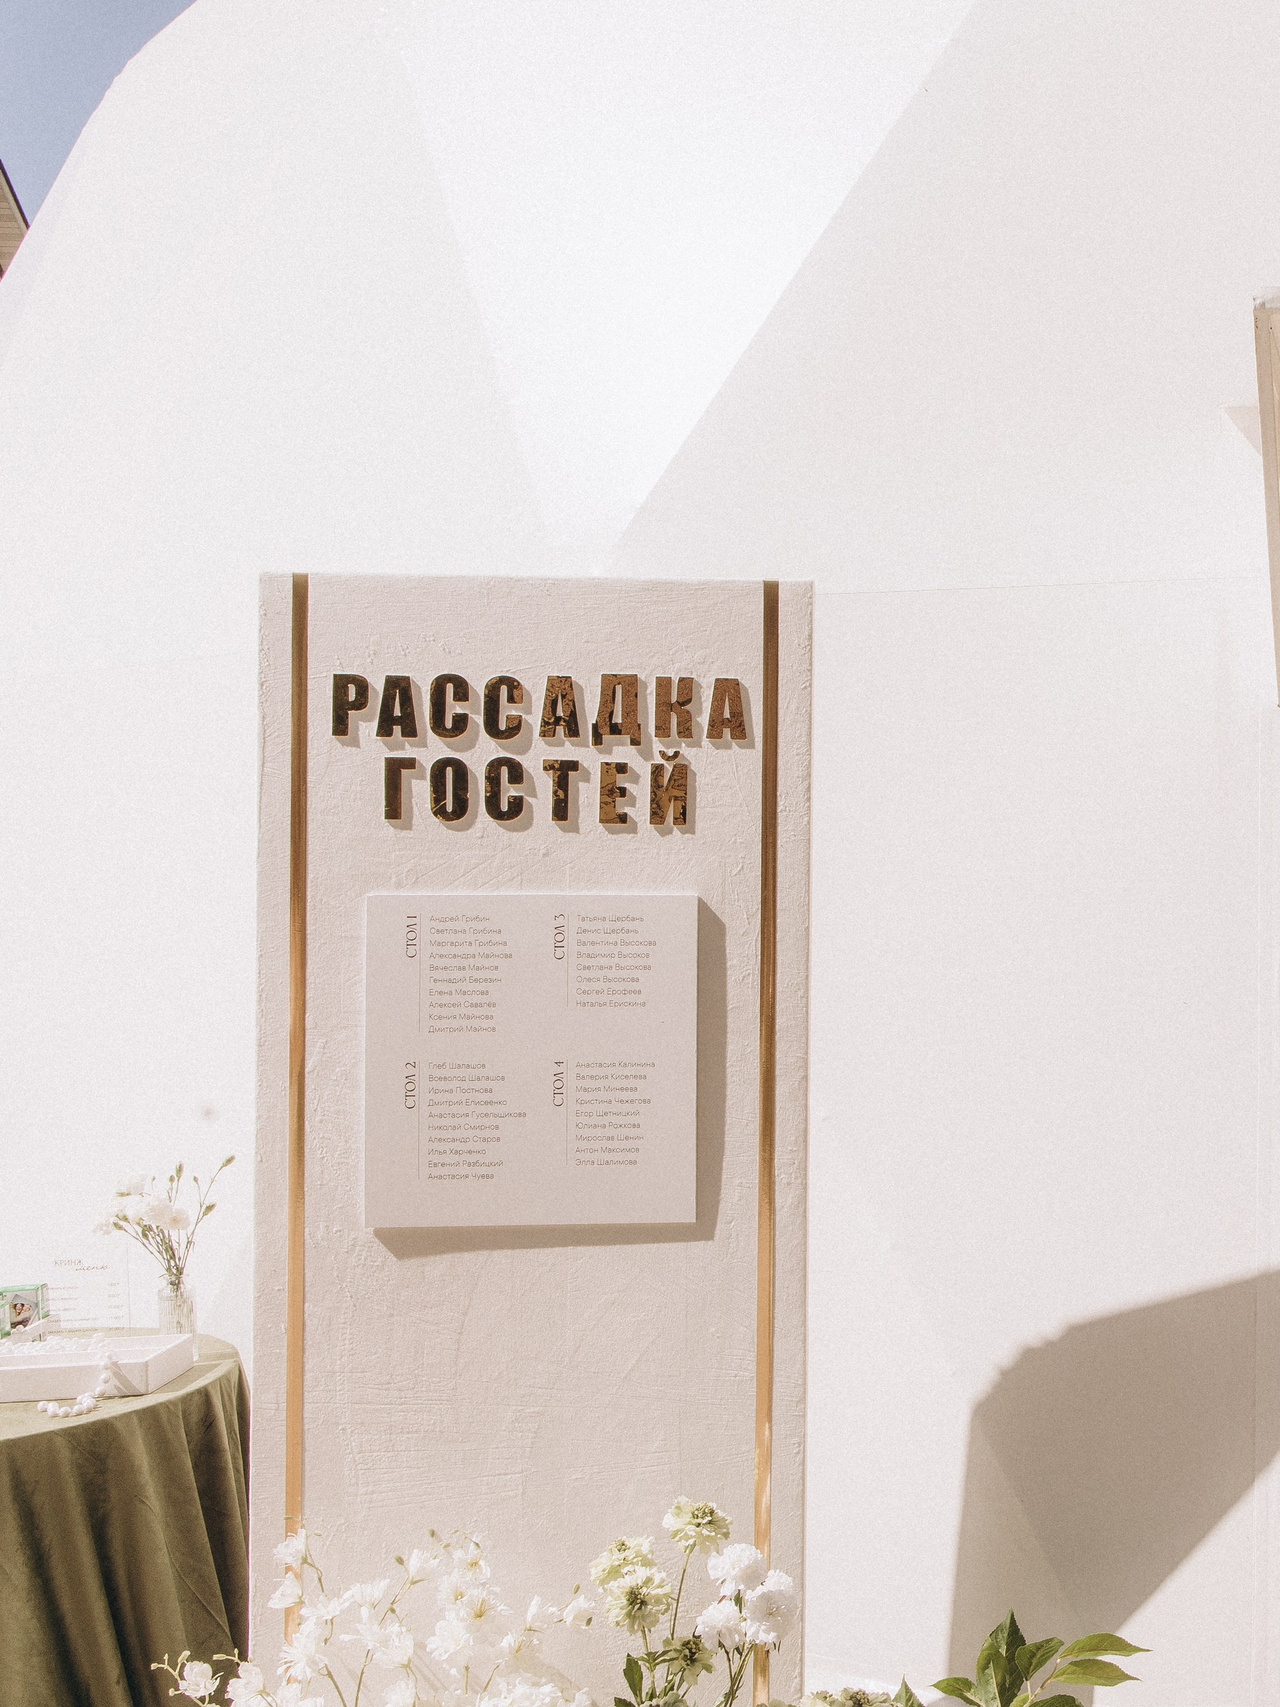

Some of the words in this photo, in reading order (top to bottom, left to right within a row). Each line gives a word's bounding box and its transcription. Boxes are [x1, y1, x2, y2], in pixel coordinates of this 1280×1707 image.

[331, 673, 748, 746] РАССАДКА
[384, 750, 688, 825] ГОСТЕЙ
[430, 915, 459, 923] Андрей
[462, 915, 490, 923] Грибин
[609, 915, 644, 923] Щербань
[468, 927, 501, 935] Грибина
[577, 927, 601, 935] Денис
[604, 927, 639, 935] Щербань
[406, 923, 417, 958] СТОЛ
[430, 940, 472, 948] Маргарита
[554, 925, 565, 960] СТОЛ
[430, 952, 475, 960] Александра
[577, 951, 615, 959] Владимир
[469, 976, 502, 984] Березин
[576, 988, 604, 996] Сергей
[607, 988, 642, 996] Ерофеев
[576, 1073, 608, 1081] Валерия
[405, 1074, 416, 1109] СТОЛ
[553, 1072, 564, 1107] СТОЛ
[428, 1099, 463, 1107] Дмитрий
[575, 1110, 593, 1118] Егор
[428, 1136, 470, 1144] Александр
